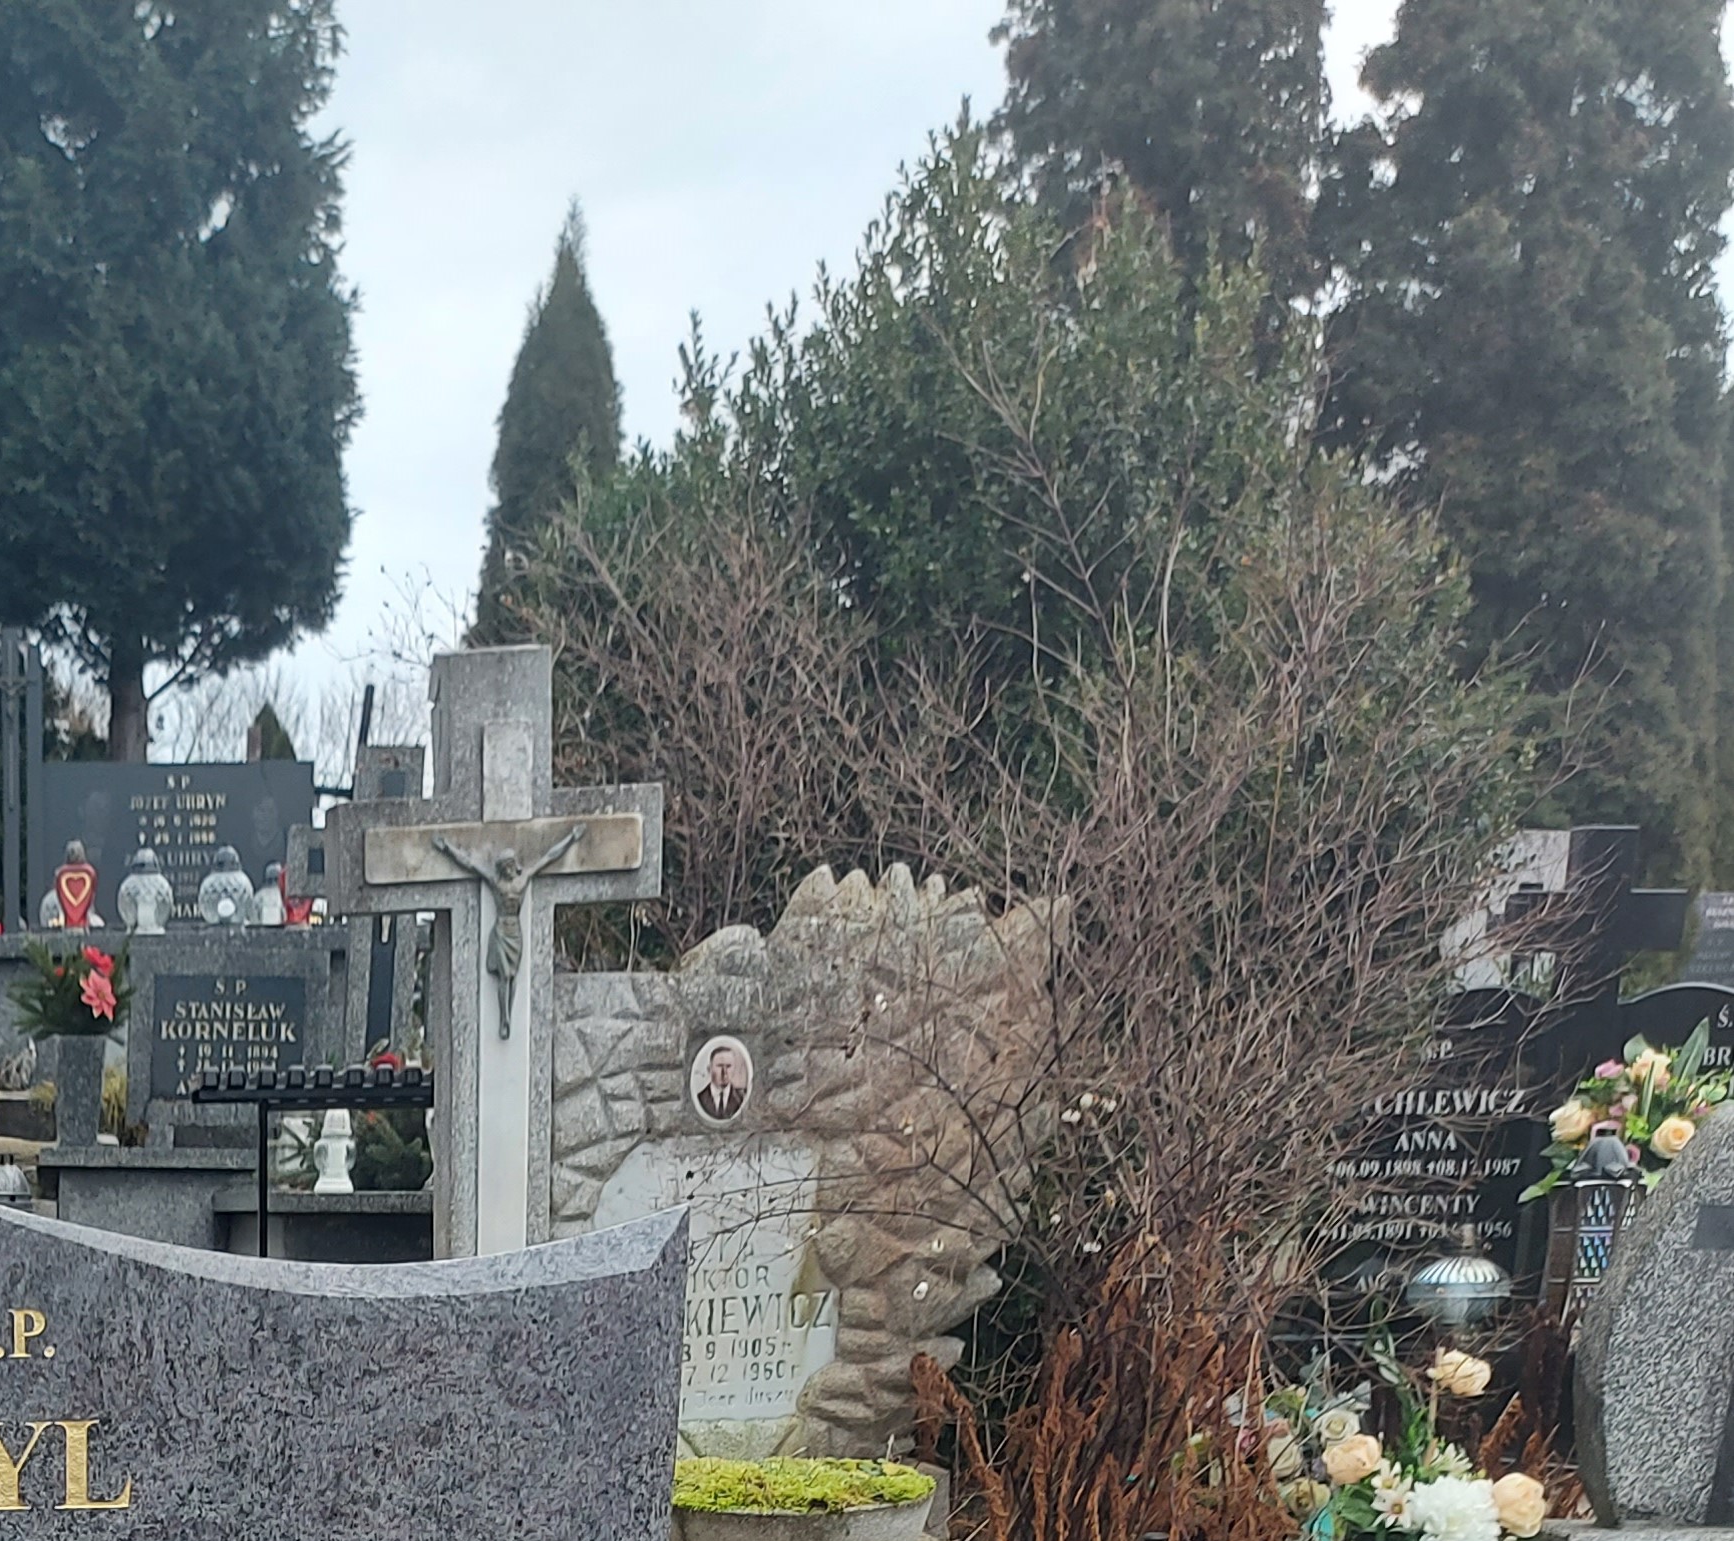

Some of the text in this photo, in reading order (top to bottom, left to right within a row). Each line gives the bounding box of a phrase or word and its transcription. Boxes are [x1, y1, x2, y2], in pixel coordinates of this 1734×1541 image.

[175, 1001, 286, 1020] STANISŁAW
[160, 1020, 297, 1042] KORNELUK
[1393, 1131, 1458, 1152] ANNA
